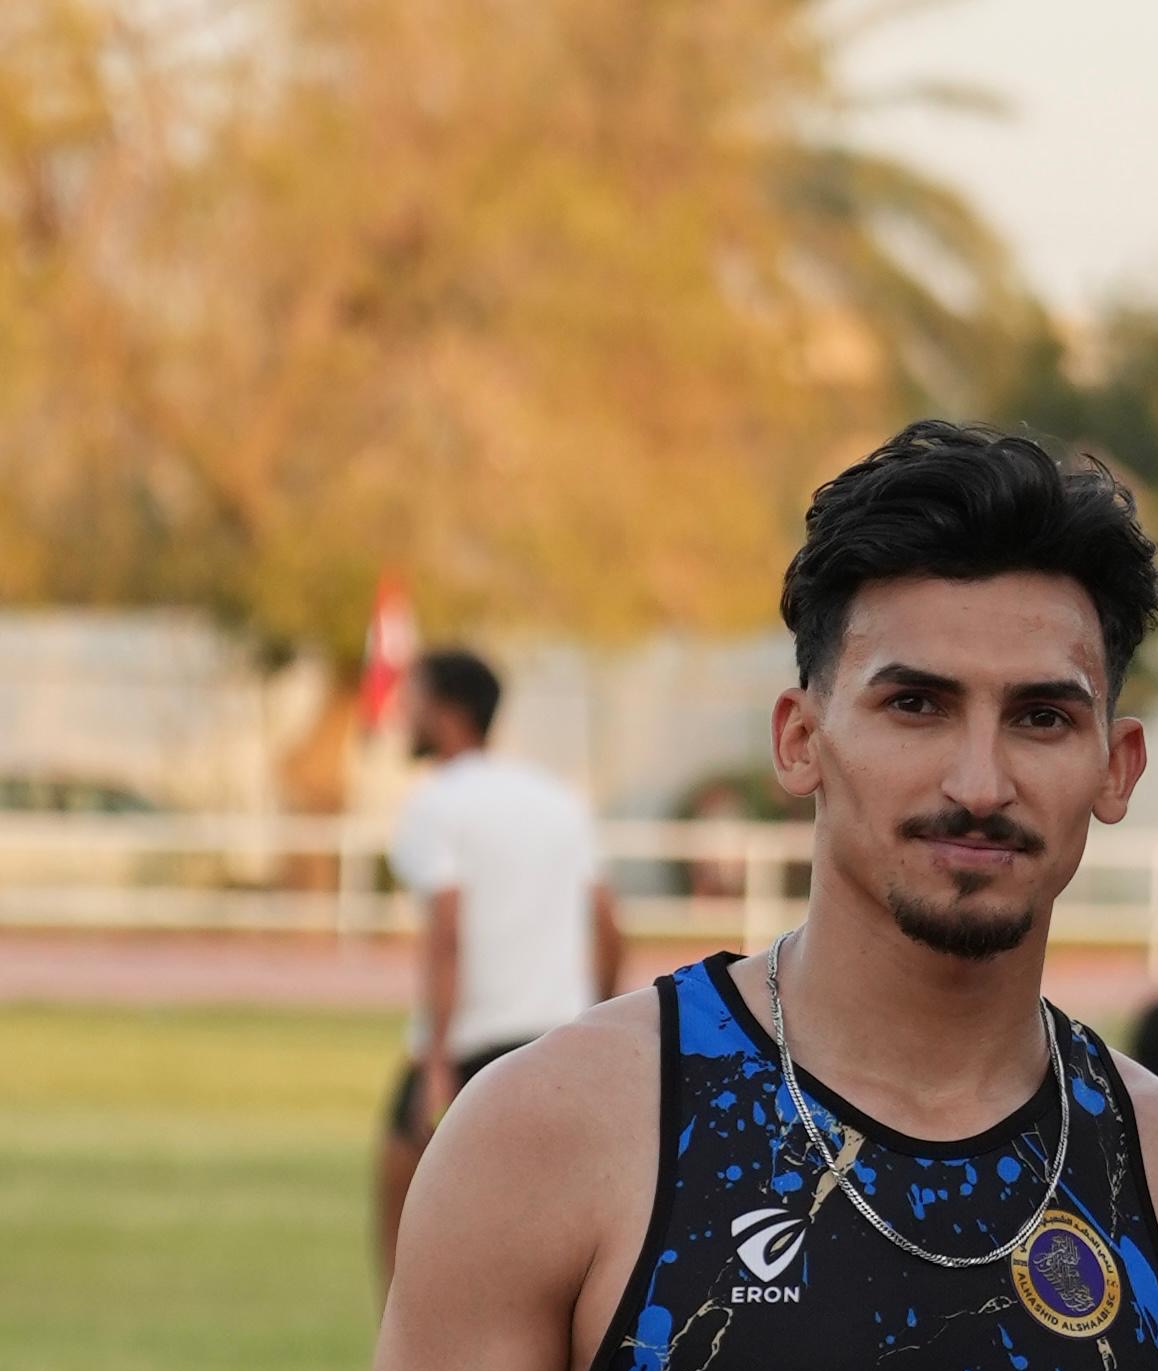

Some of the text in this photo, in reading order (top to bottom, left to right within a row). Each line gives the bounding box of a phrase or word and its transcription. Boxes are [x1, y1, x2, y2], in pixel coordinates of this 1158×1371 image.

[731, 1286, 800, 1303] ERON
[1017, 1272, 1059, 1326] ALHASHID
[1061, 1309, 1111, 1332] ALSHAABI
